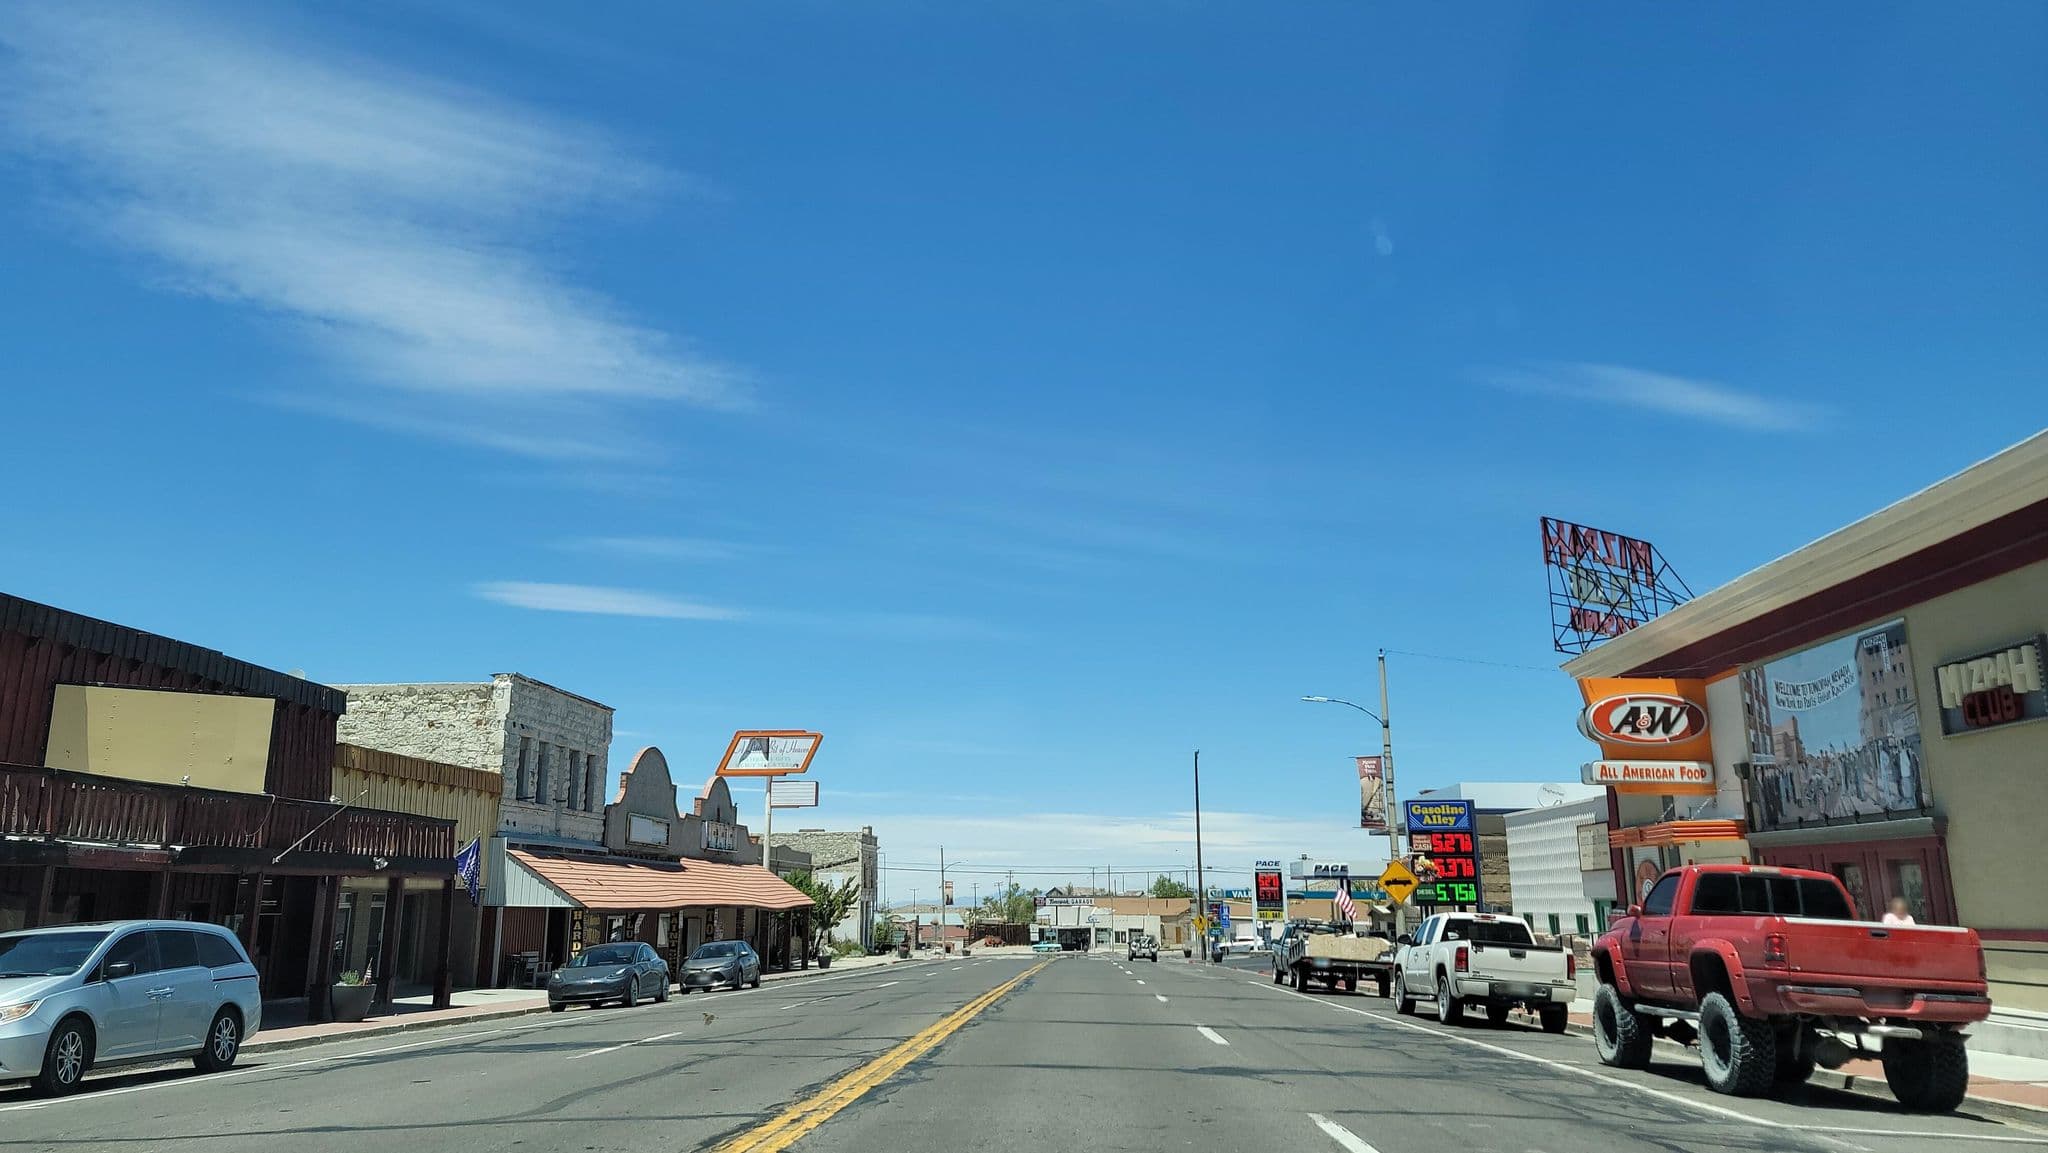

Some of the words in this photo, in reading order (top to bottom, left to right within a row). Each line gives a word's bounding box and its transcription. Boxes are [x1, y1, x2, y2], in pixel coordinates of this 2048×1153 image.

[1774, 680, 1801, 697] WELCOME
[1831, 663, 1851, 682] NEVADA
[1938, 645, 2041, 709] MIZPAH
[1775, 694, 1786, 707] New
[1803, 697, 1817, 709] Paris
[1963, 687, 2019, 727] CLUB
[1611, 705, 1690, 735] A&W
[1600, 765, 1618, 779] ALL
[1622, 765, 1675, 780] AMERICAN
[1680, 766, 1707, 779] FOOD
[1411, 804, 1465, 815] Gasoline
[1423, 815, 1456, 826] Alley
[1414, 842, 1432, 851] CASH
[1314, 864, 1349, 873] PACE
